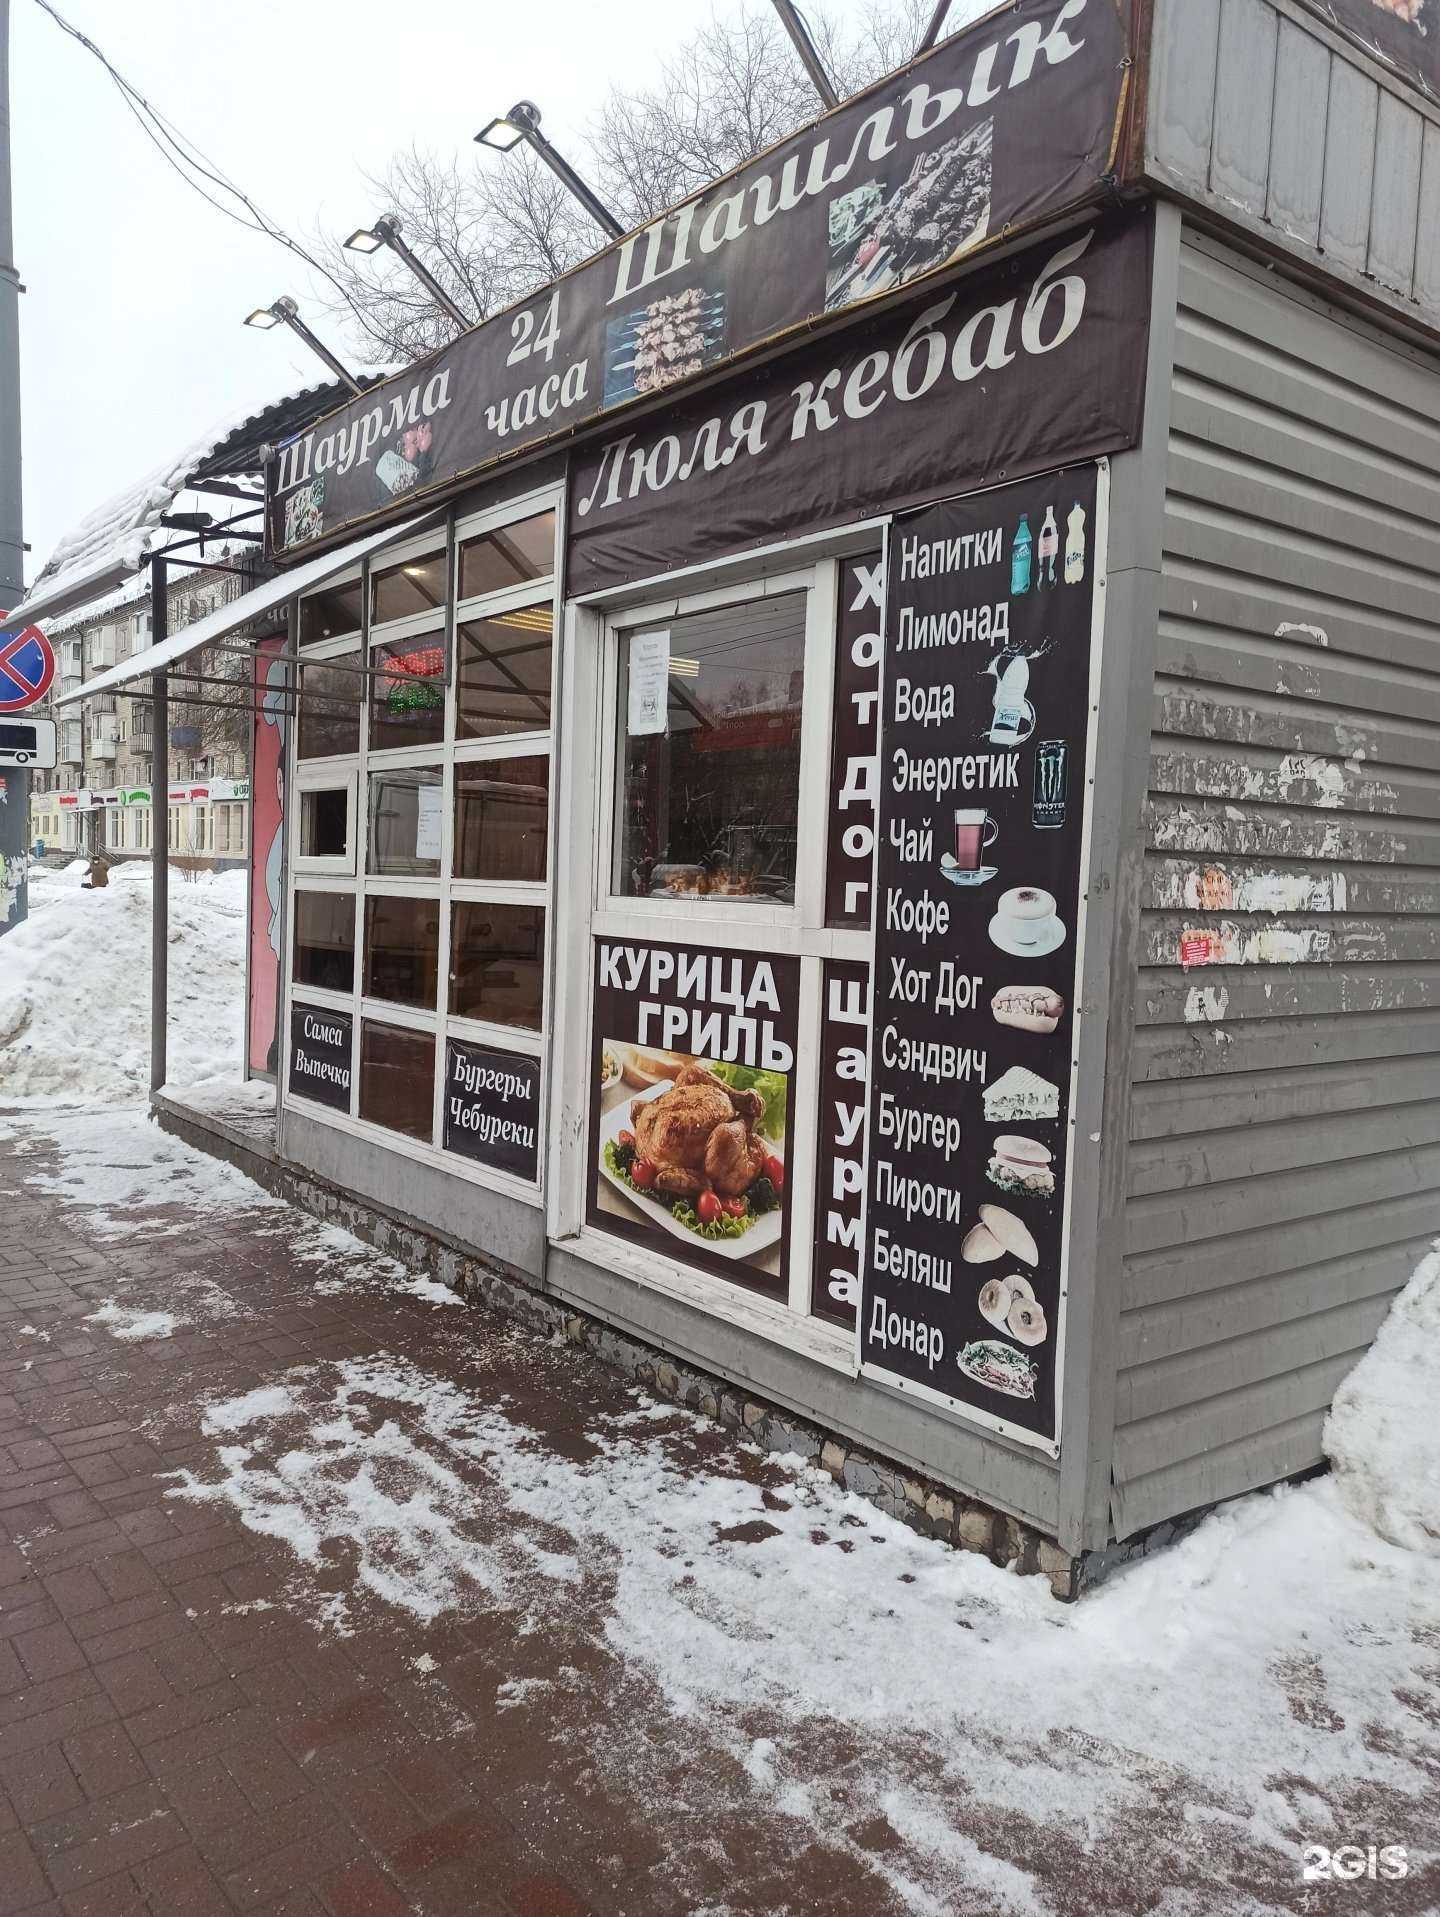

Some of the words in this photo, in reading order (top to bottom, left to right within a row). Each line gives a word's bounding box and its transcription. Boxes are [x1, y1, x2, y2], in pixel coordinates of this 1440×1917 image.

[606, 0, 1087, 305] Шашлык
[506, 290, 561, 368] 24
[484, 358, 589, 437] часа
[578, 399, 768, 516] Люля
[791, 228, 1095, 440] кебаб
[275, 367, 452, 497] Шаурма
[901, 528, 1003, 582] Напитки
[896, 601, 1010, 652] Лимонад
[895, 678, 954, 728] Вода
[893, 748, 1020, 802] Энергетик
[889, 818, 933, 864] Чай
[886, 888, 950, 943] Кофе
[599, 944, 780, 1016] КУРИЦА
[889, 956, 931, 1003] Хот
[935, 961, 983, 1016] Дог
[304, 1014, 343, 1047] Самса
[638, 1000, 794, 1072] ГРИЛЬ
[882, 1025, 987, 1085] Сэндвич
[295, 1048, 350, 1090] Выпечка
[453, 1053, 532, 1103] Бургеры
[450, 1097, 535, 1149] Чебуреки
[878, 1093, 960, 1161] Бургер
[876, 1161, 961, 1225] Пироги
[873, 1229, 952, 1294] Беляш
[868, 1295, 944, 1370] Донар
